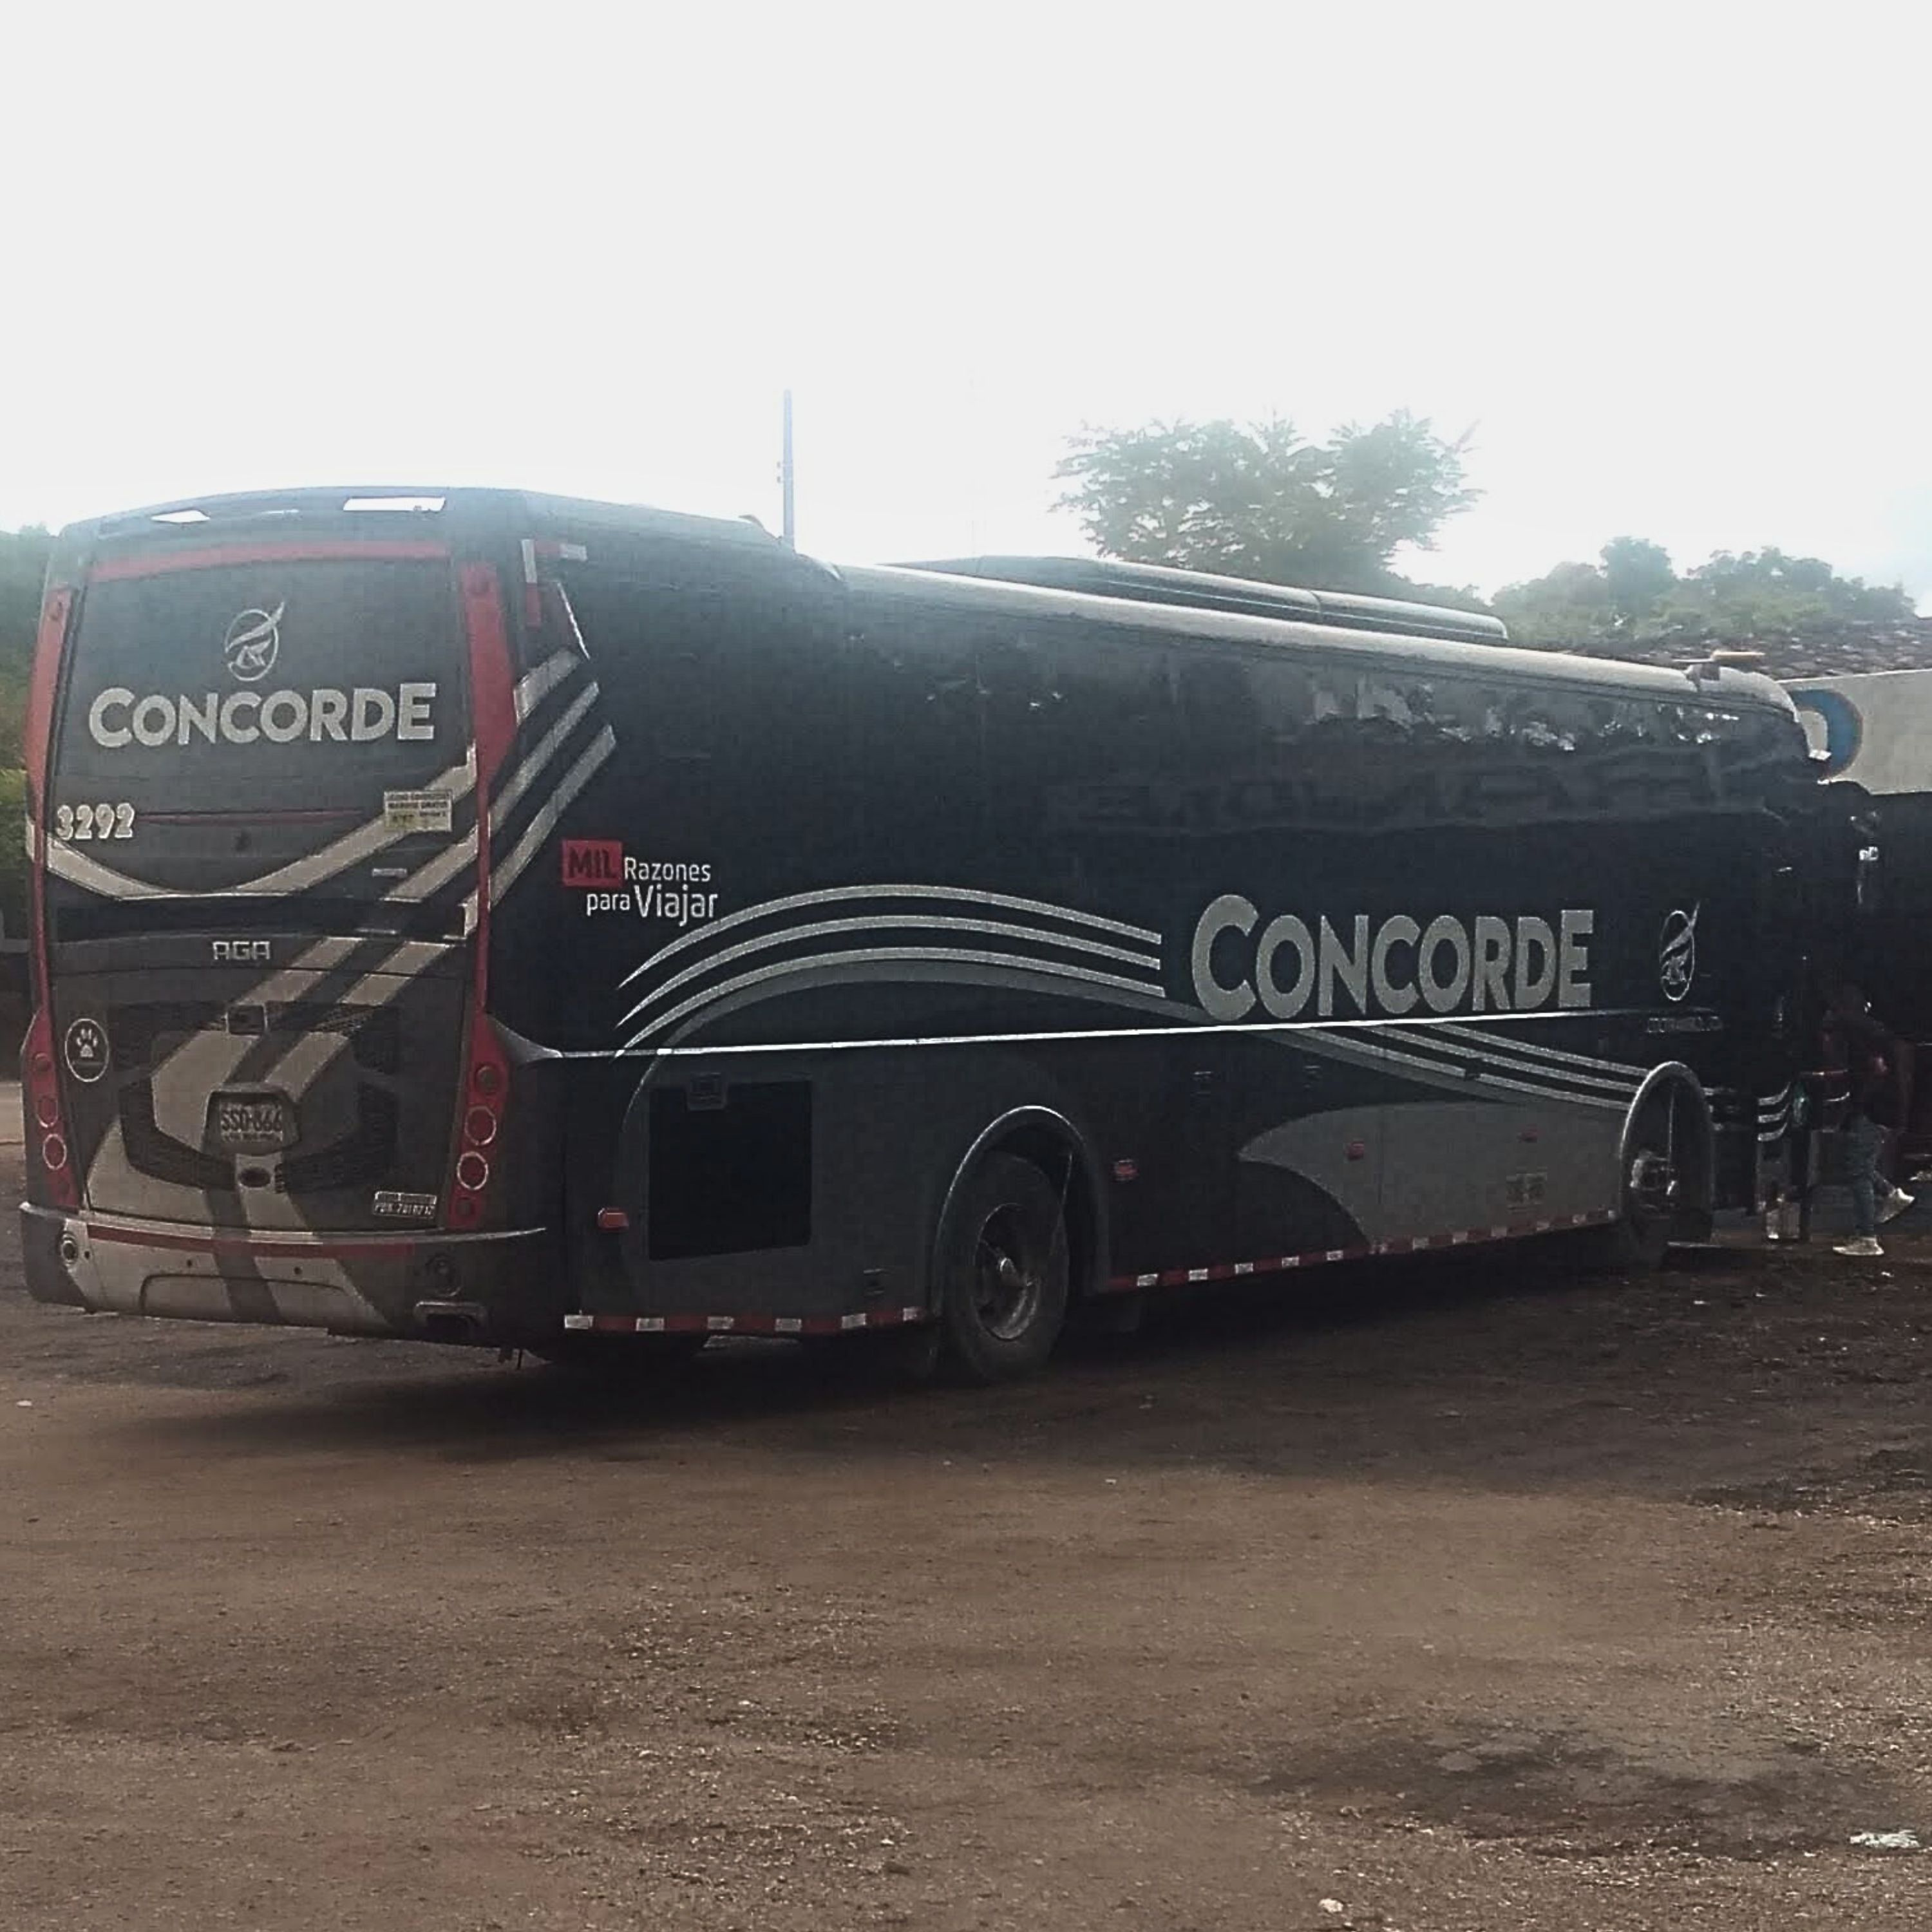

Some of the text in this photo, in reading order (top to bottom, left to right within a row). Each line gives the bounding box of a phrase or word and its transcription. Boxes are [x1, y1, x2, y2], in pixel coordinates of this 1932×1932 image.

[88, 683, 437, 748] CONCORDE
[55, 802, 136, 840] 3292
[567, 845, 712, 883] MIL Razones
[586, 884, 719, 927] para Viajar
[212, 940, 271, 961] AGA
[1191, 893, 1595, 1022] CONCORDE
